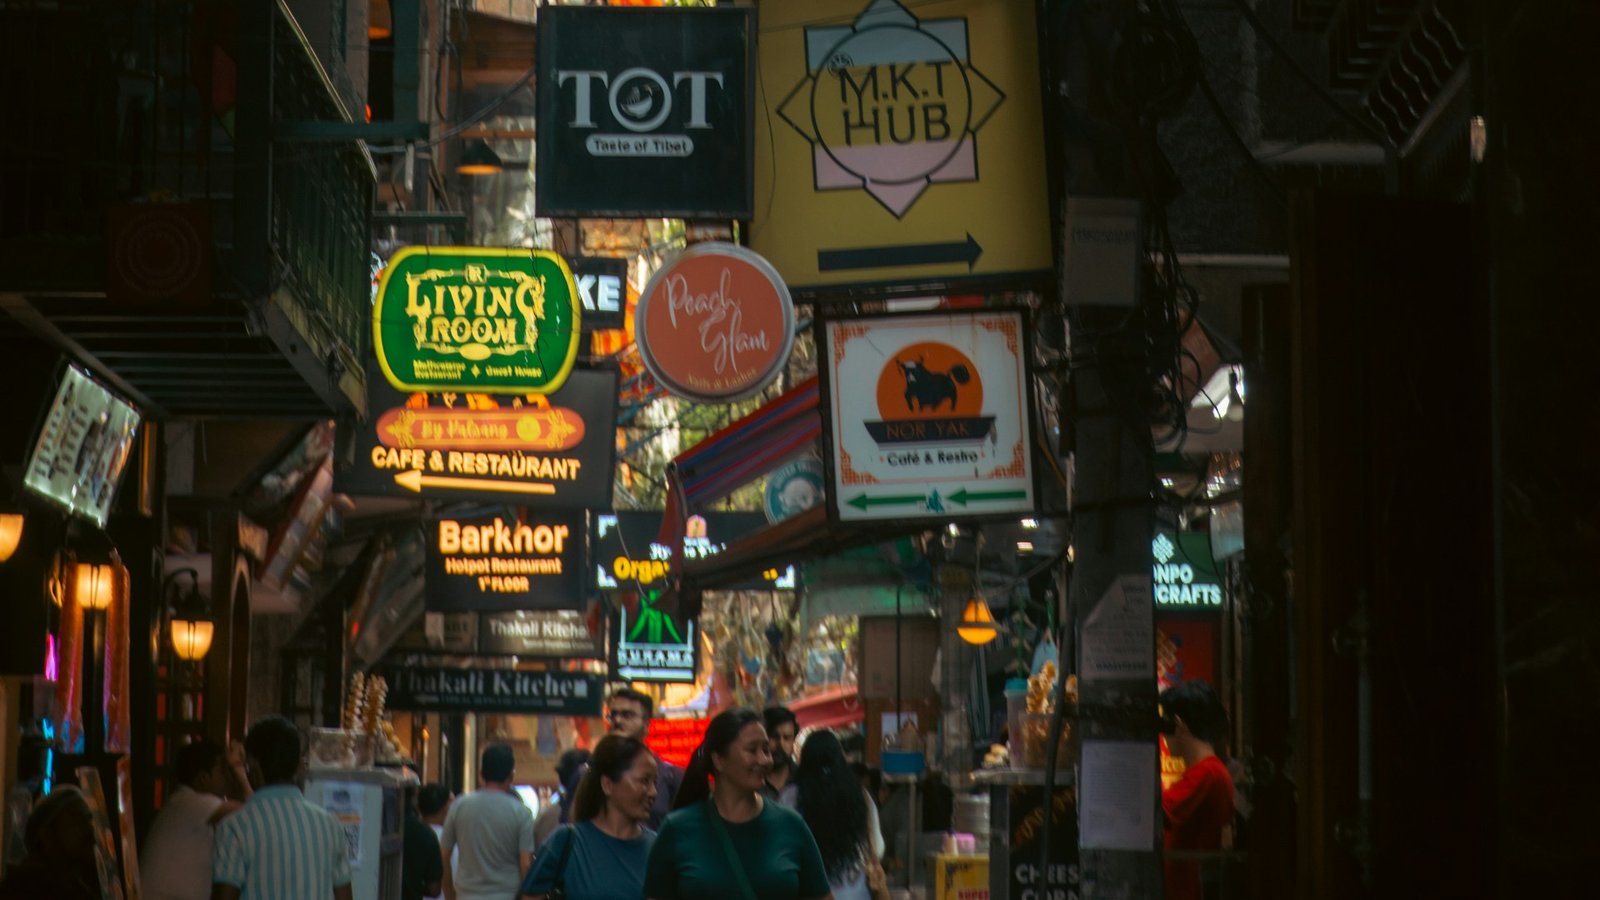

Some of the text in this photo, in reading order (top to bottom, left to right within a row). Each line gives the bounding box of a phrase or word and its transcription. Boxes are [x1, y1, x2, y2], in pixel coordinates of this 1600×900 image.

[838, 60, 952, 103] M.K.T
[558, 67, 724, 132] TOT
[844, 103, 950, 146] HUB
[594, 138, 688, 153] Taste of Tibet
[662, 267, 741, 330] Peach
[431, 316, 517, 344] ROOM
[699, 308, 769, 375] Glam
[886, 420, 970, 439] NOR YAK
[371, 445, 582, 481] CAFE & RESTAURANT
[923, 451, 935, 465] &
[437, 516, 570, 555] Barkhor
[445, 556, 563, 576] Hotpot Restaurant
[491, 575, 530, 593] FLOOR
[489, 617, 540, 637] Thakali
